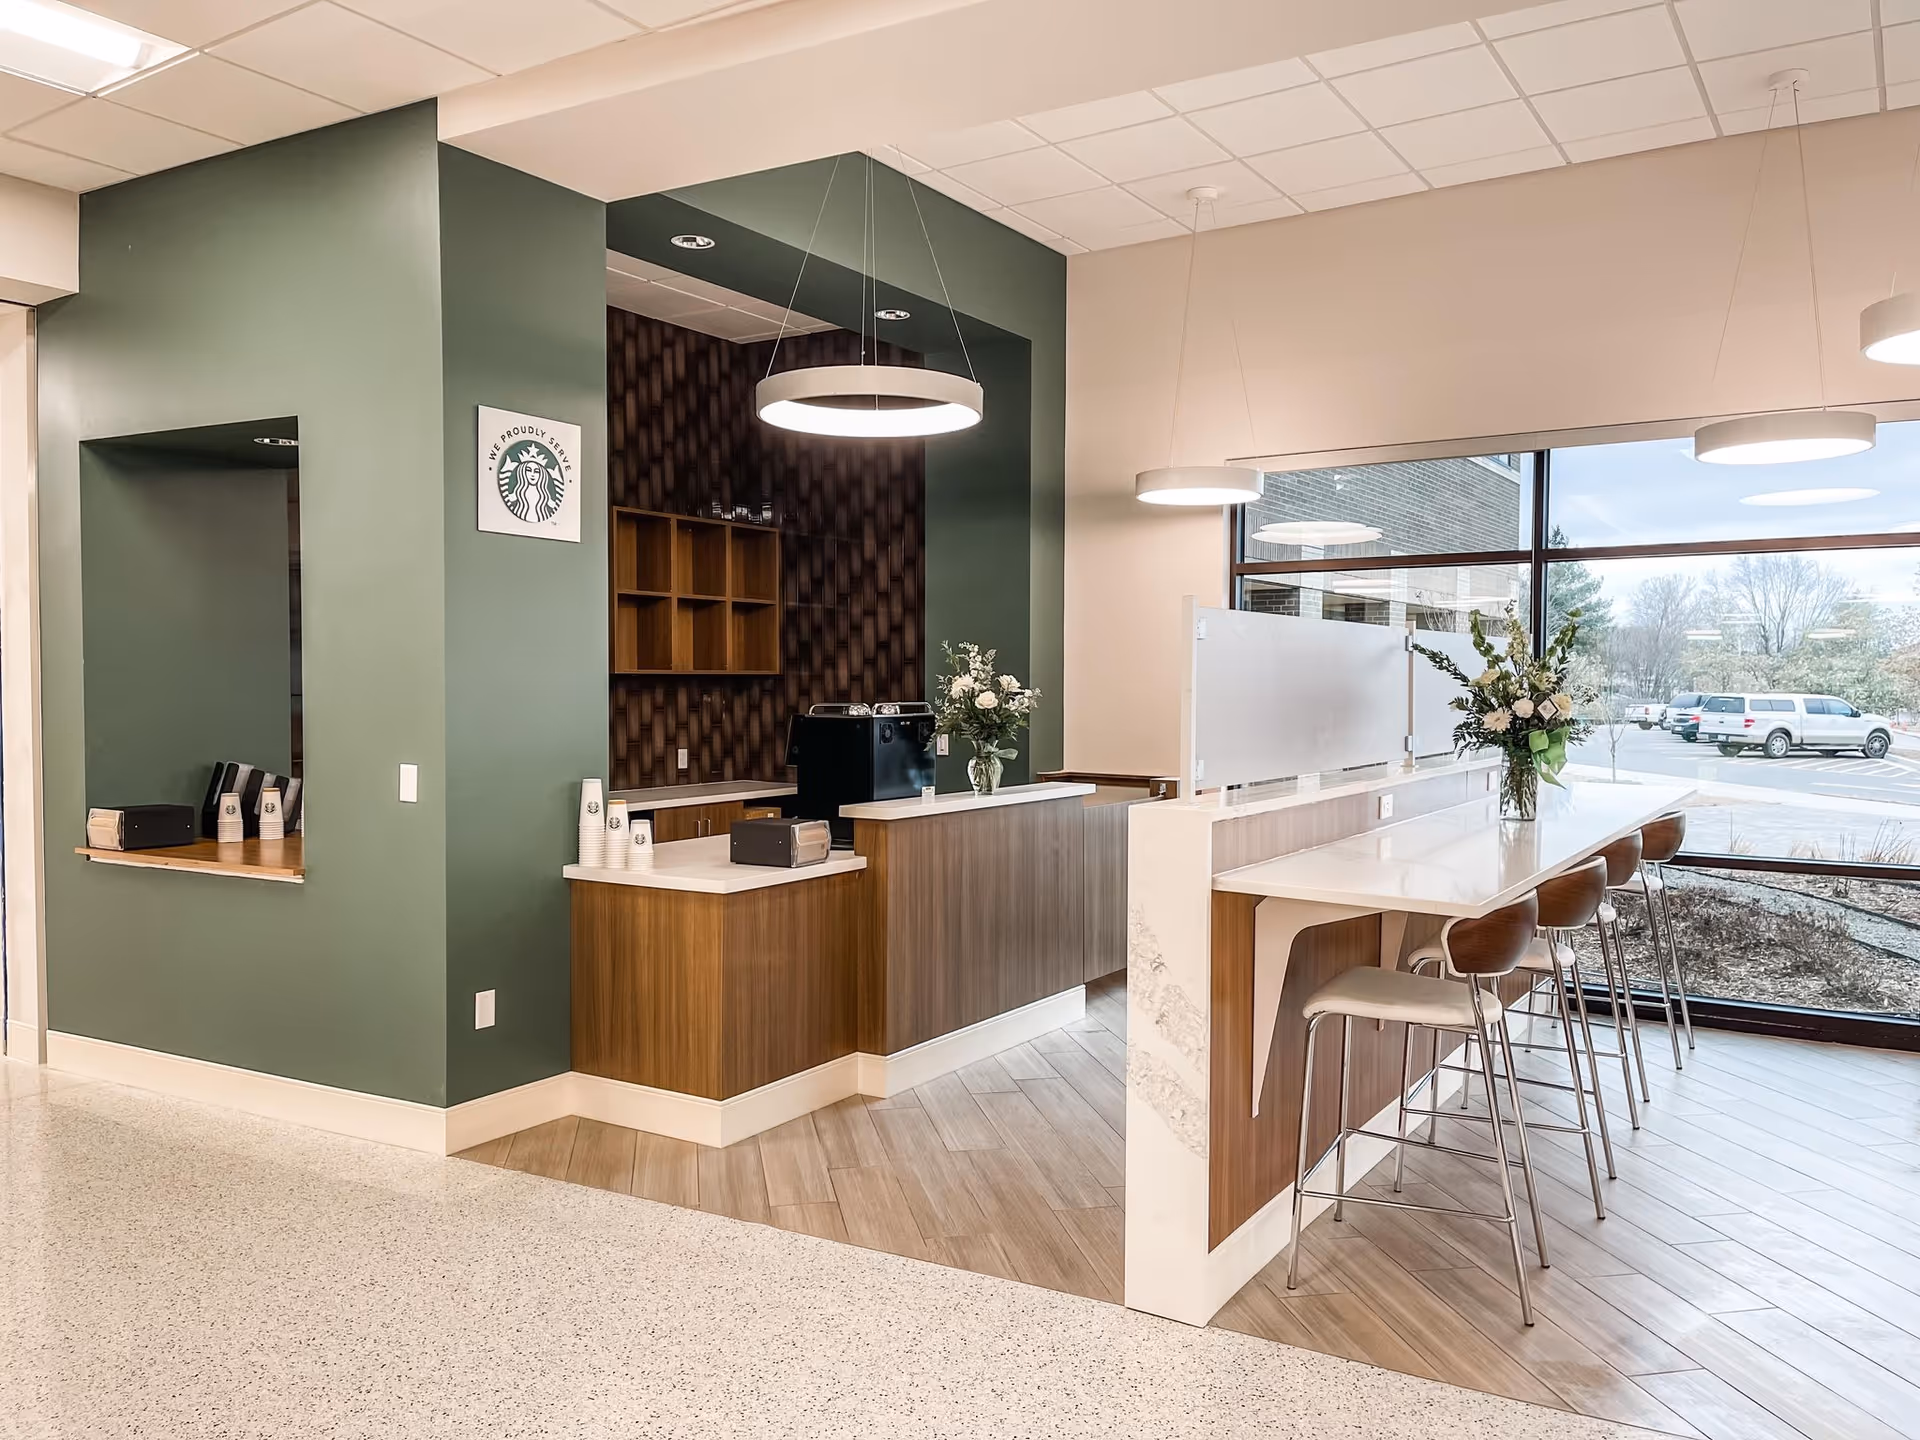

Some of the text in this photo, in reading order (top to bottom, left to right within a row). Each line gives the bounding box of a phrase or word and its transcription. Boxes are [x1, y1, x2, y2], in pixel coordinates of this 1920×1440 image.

[489, 426, 572, 472] WE PROUDLY SERVE
